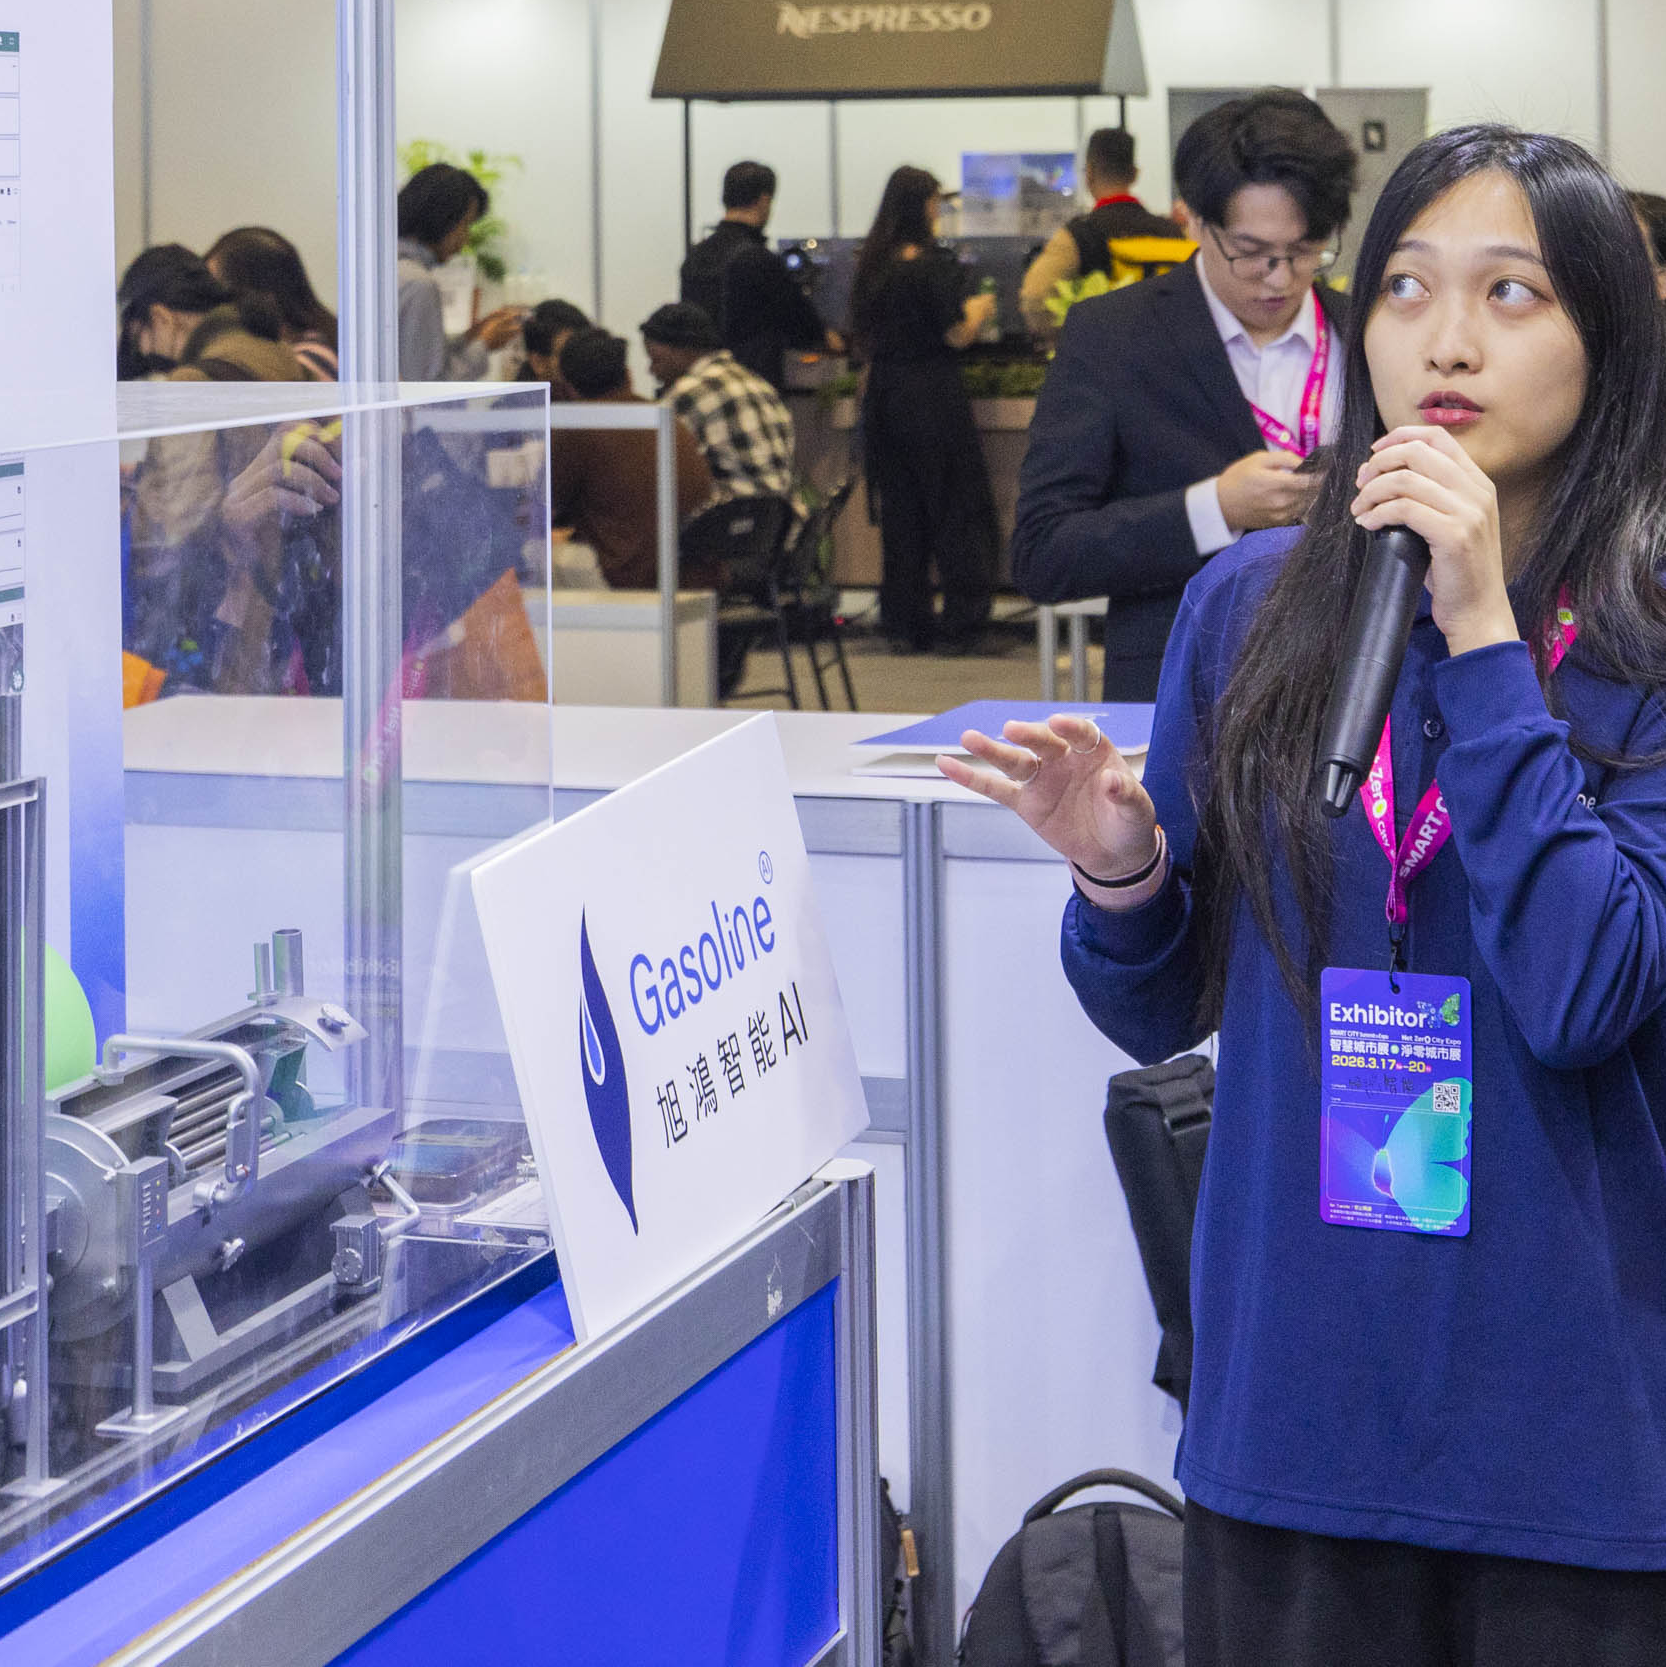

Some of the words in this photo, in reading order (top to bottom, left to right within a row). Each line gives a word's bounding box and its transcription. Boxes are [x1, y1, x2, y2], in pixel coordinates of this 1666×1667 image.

[776, 0, 993, 40] NESPRESSO
[1399, 810, 1444, 878] SMART
[629, 893, 776, 1036] Gasoline
[1330, 1001, 1429, 1029] Exhibitor
[1330, 1038, 1390, 1057] 智慧城市展
[1401, 1034, 1413, 1042] Net
[1445, 1038, 1462, 1046] Expo
[1401, 1043, 1462, 1062] 淨零城市展
